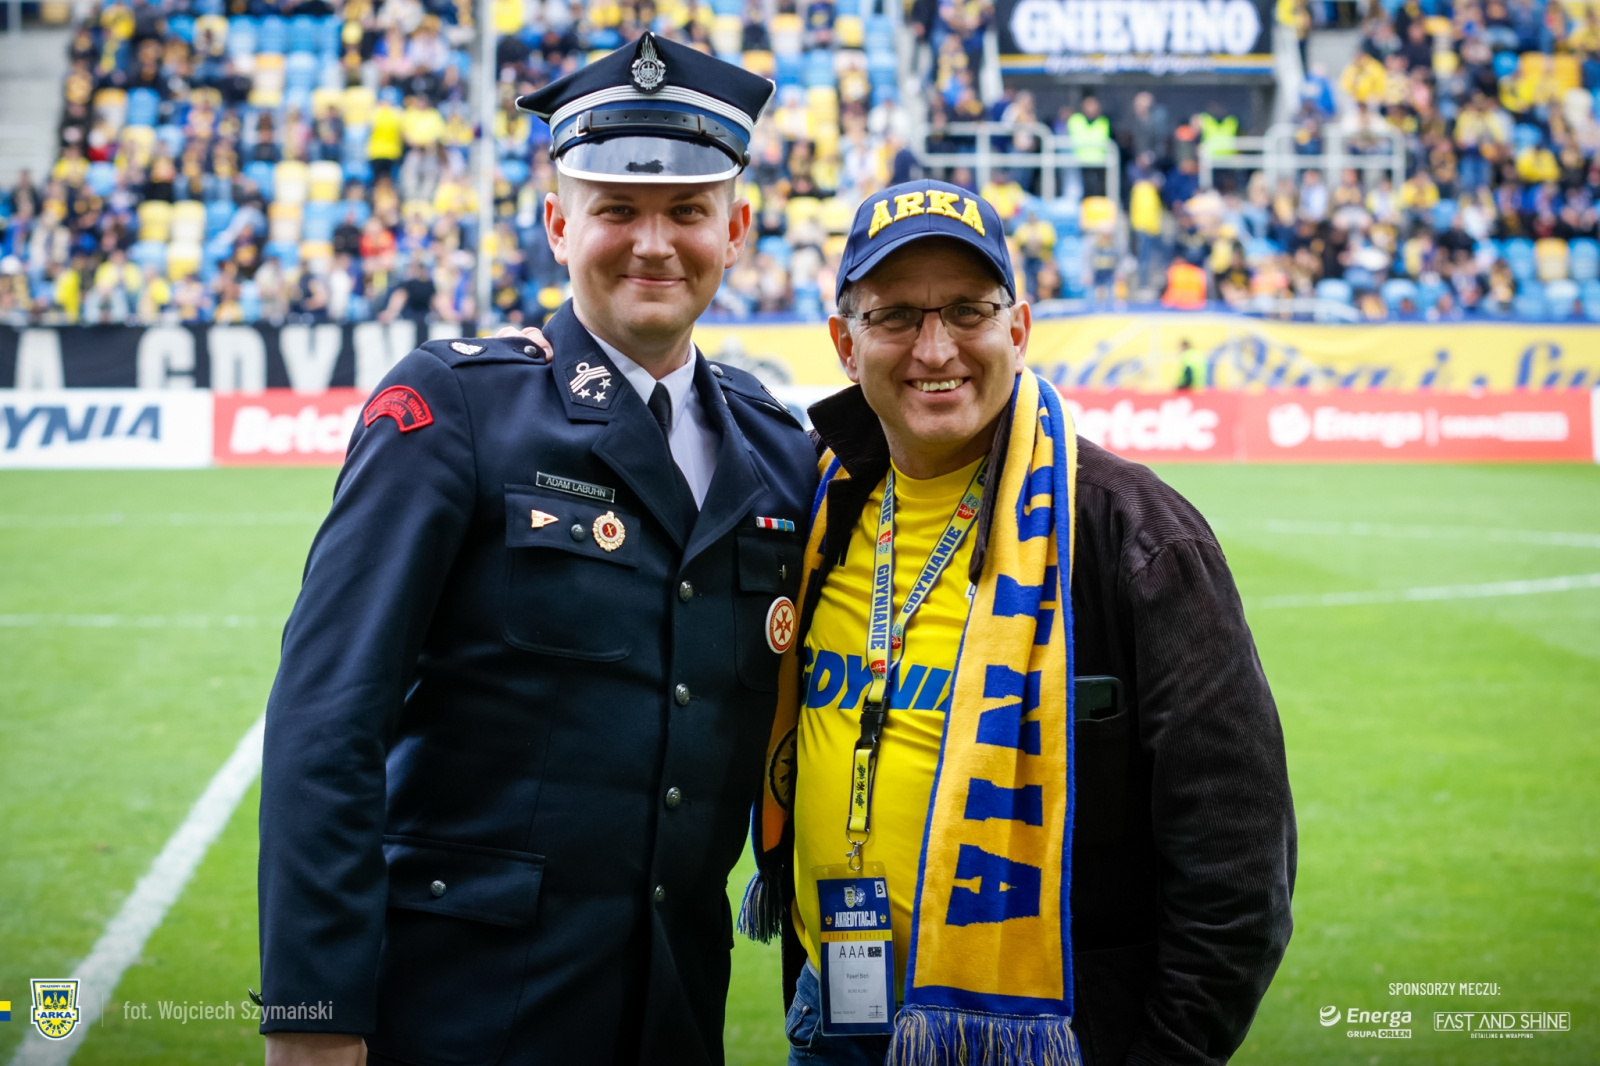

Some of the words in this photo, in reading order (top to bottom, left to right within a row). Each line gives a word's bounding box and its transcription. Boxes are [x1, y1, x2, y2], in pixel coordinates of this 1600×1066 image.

[1009, 0, 1260, 54] GNIEWINO
[868, 190, 986, 239] ARKA
[229, 405, 366, 454] Betcl
[545, 477, 570, 490] ADAM
[572, 483, 606, 497] LABUHN
[903, 526, 962, 614] GDYNIANIE
[871, 563, 890, 650] GDYNIANIE
[802, 648, 953, 711] DYNI
[835, 910, 878, 928] AKREDYTACJA
